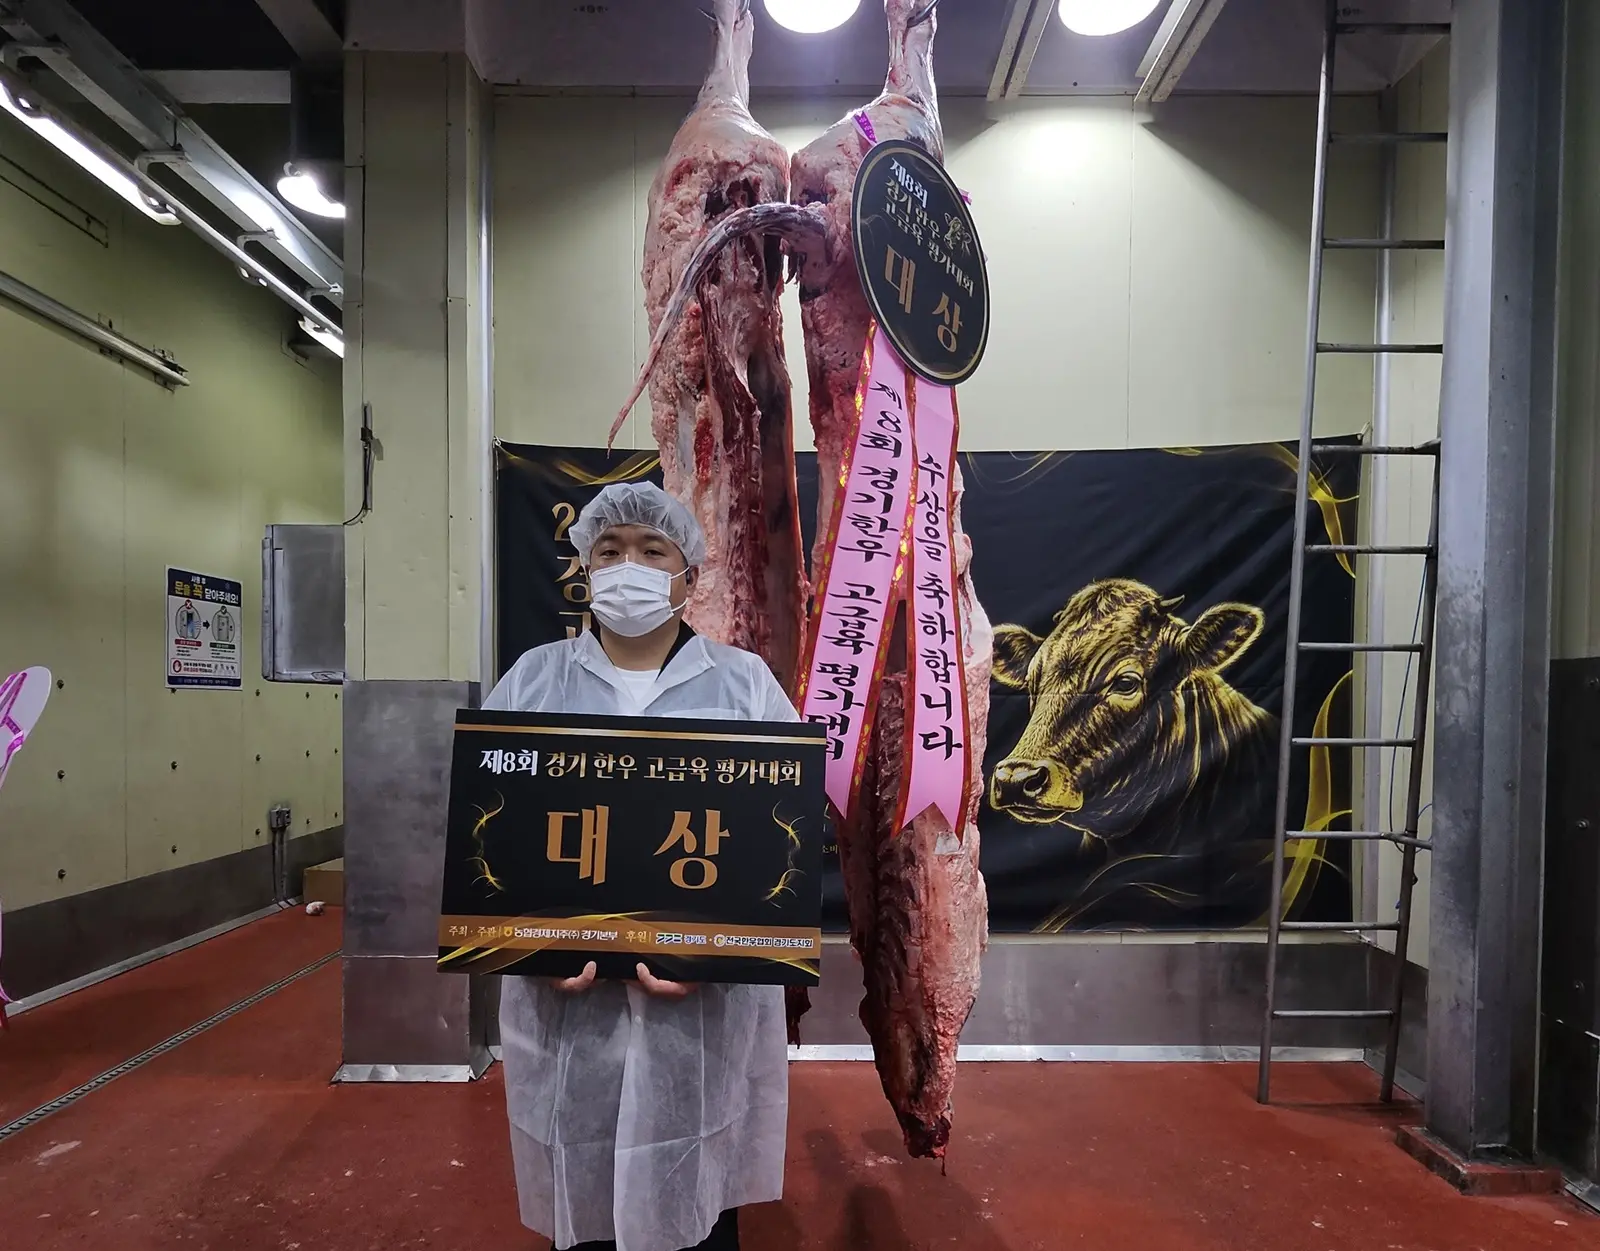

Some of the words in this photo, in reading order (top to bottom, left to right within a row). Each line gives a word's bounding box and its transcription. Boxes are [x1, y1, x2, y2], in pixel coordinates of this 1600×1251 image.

[885, 175, 913, 215] 경기
[889, 157, 928, 209] 제8회
[882, 195, 924, 247] 고급육
[927, 237, 974, 298] 평가대회
[860, 381, 903, 459] 제8회
[916, 452, 947, 562] 수상을
[174, 580, 190, 596] 문을
[193, 583, 204, 599] 꼭
[822, 581, 883, 656] 고급육
[916, 571, 963, 761] 축하합니다
[478, 749, 539, 776] 제8회
[544, 752, 587, 778] 경기
[593, 752, 637, 779] 한우
[644, 757, 709, 782] 고급육
[714, 757, 801, 786] 평가대회
[448, 925, 468, 937] 주최
[581, 928, 618, 941] 경기본부
[625, 930, 647, 943] 후원
[684, 934, 707, 944] 경기도
[726, 936, 772, 947] 전국한우협회
[773, 937, 813, 948] 경기도지회
